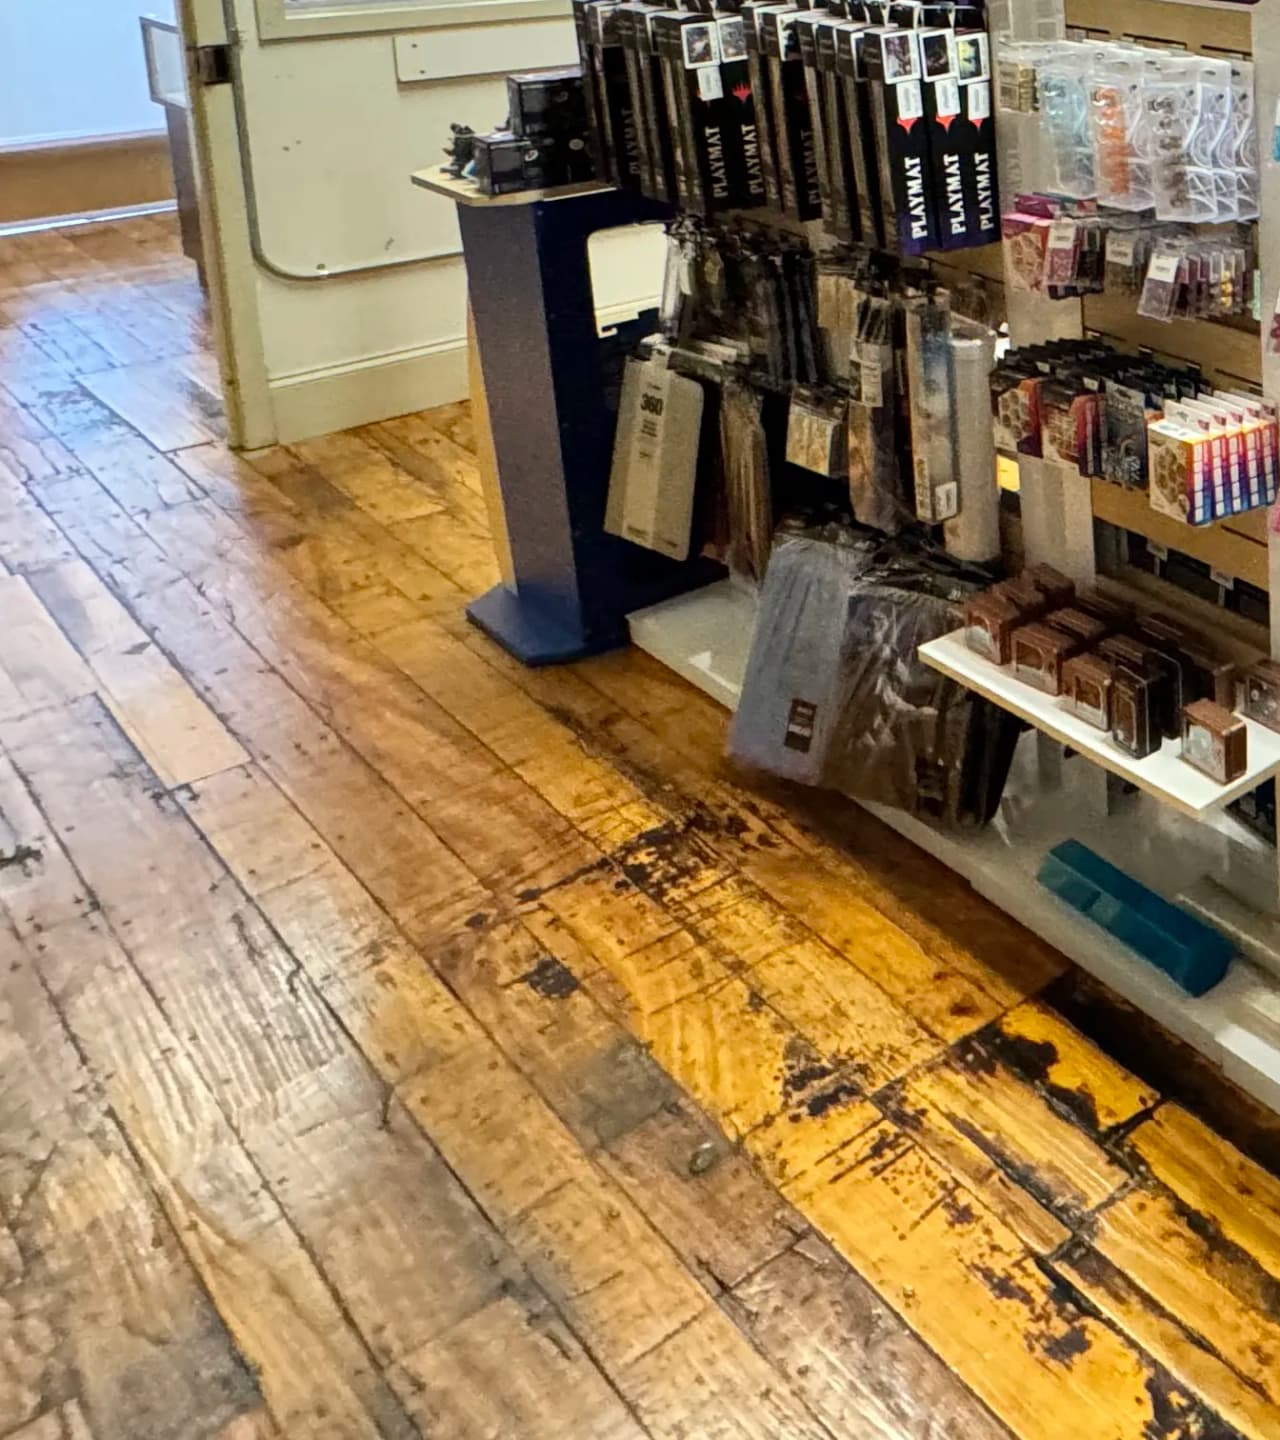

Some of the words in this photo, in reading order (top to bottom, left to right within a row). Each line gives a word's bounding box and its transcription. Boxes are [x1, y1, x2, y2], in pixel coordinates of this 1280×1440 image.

[704, 126, 726, 198] PLAYMAT
[741, 124, 764, 194] PLAYMAT
[943, 153, 966, 235] PLAYMAT
[974, 153, 995, 232] PLAYMAT
[903, 157, 928, 239] PLAYMAT
[640, 392, 664, 417] 360
